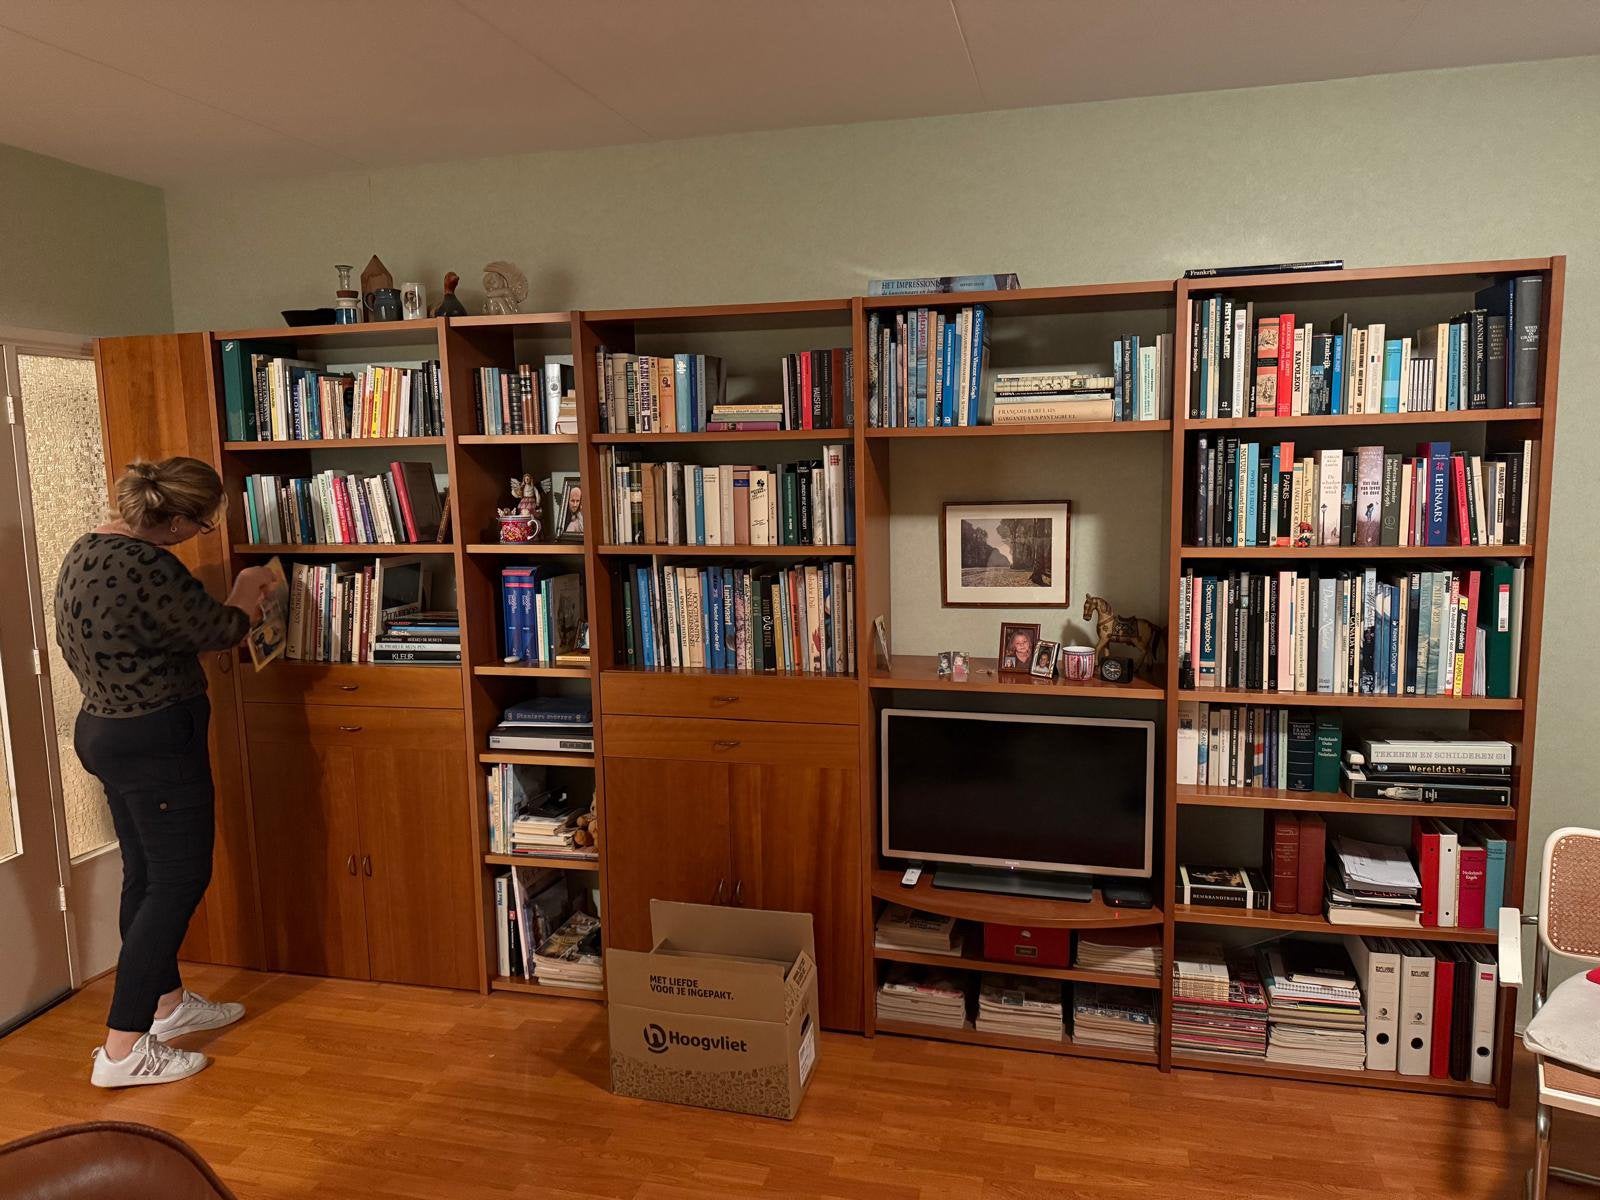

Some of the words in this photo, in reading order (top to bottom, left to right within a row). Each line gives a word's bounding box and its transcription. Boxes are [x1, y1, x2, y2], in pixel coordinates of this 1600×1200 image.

[1476, 315, 1484, 341] JEANNE
[1322, 337, 1332, 368] Frankrijk
[640, 366, 650, 379] JAN
[1294, 350, 1302, 392] NAPOLEON
[294, 391, 302, 434] FLORENCE
[1238, 486, 1246, 503] maand
[722, 585, 732, 625] Luchtvaart
[1348, 616, 1356, 647] CANADA
[1375, 751, 1418, 759] TEKENEN
[1408, 765, 1467, 773] Wereldatlas
[650, 975, 666, 985] MET
[669, 977, 698, 988] LIEFDE
[650, 984, 674, 995] VOOR
[676, 986, 686, 996] JE
[688, 988, 734, 1000] INGEPAKT.
[668, 1031, 748, 1053] Hoogvliet
